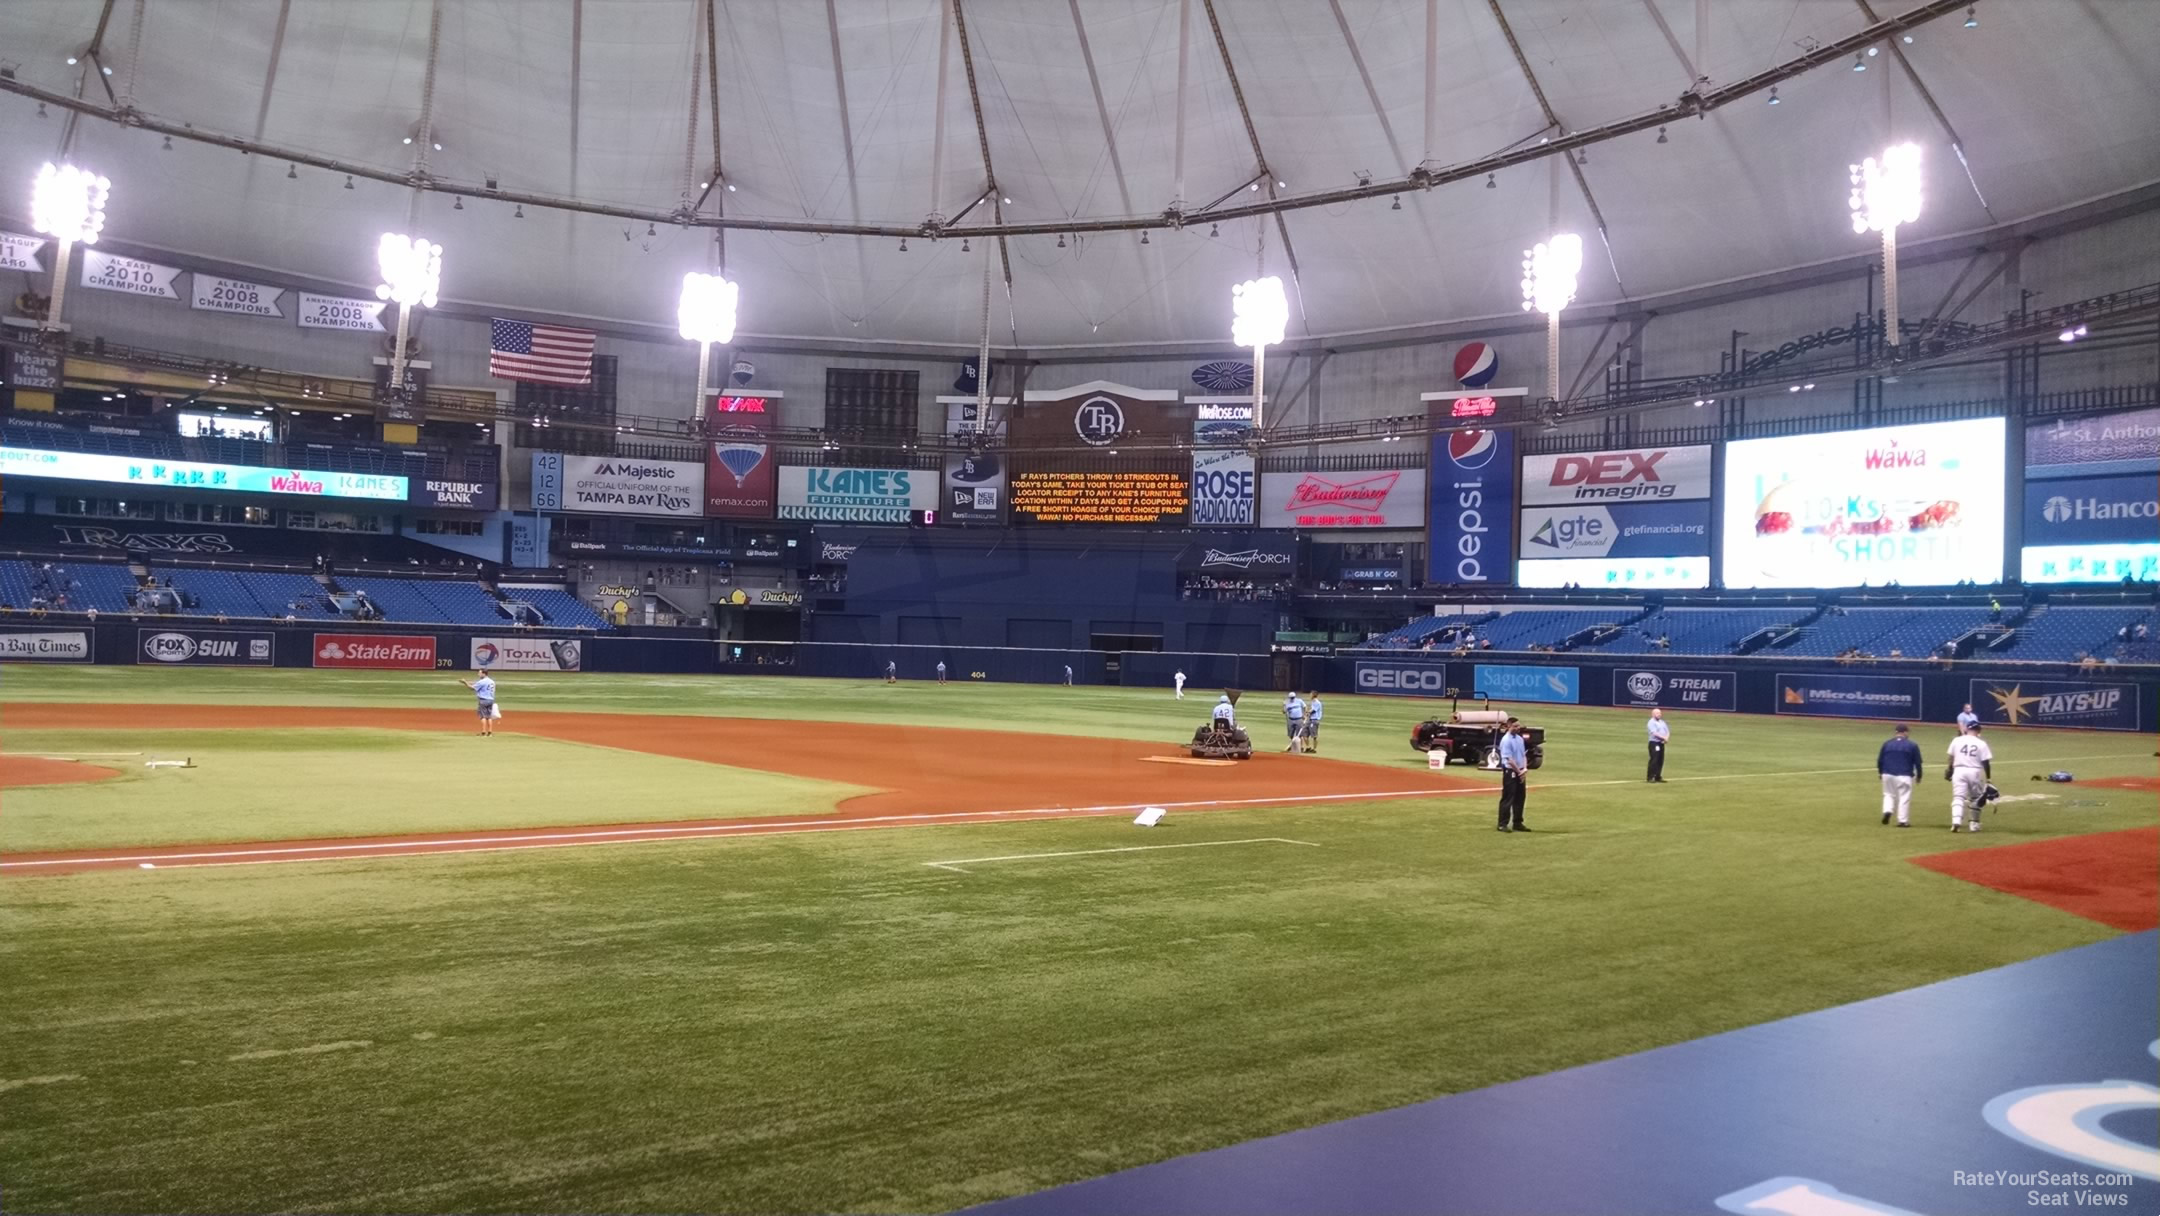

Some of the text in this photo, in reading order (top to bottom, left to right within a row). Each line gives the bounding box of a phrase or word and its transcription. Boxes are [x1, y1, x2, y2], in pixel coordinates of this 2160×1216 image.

[126, 261, 152, 270] EAST
[105, 266, 154, 284] 2010
[89, 275, 166, 296] CHAMPIONS
[213, 288, 259, 304] 2008
[199, 298, 271, 314] CHAMPIONS
[319, 305, 362, 320] 2008
[304, 316, 374, 330] CHAMPIONS
[22, 364, 48, 377] the
[14, 374, 56, 388] buzz?
[8, 418, 34, 427] Know
[1084, 406, 1116, 432] TB
[90, 425, 140, 436] tampabay.com
[2075, 429, 2097, 442] St.
[538, 456, 557, 470] 42
[1865, 449, 1926, 470] Wawa
[618, 464, 675, 480] Majestic
[1549, 452, 1668, 486] DEX
[271, 475, 323, 494] Wawa
[426, 481, 483, 494] REPUBLIC
[540, 475, 554, 488] 12
[577, 480, 616, 490] OFFICIAL
[618, 483, 658, 492] UNIFORM
[808, 469, 911, 495] KANE'S
[1194, 471, 1253, 499] ROSE
[438, 492, 471, 503] BANK
[1296, 484, 1387, 502] Budweiser
[1575, 483, 1676, 499] imaging
[537, 494, 556, 506] 66
[576, 492, 624, 504] TAMPA
[628, 494, 654, 505] BAY
[711, 498, 768, 507] remax.com
[812, 497, 904, 506] FURNITURE
[1194, 500, 1252, 523] RADIOLOGY
[1454, 482, 1488, 580] pepsi
[1559, 515, 1704, 542] gte gtefinancial.org
[1567, 537, 1609, 549] financial
[1208, 553, 1252, 562] Budweiser
[1252, 554, 1290, 564] PORCH
[598, 585, 640, 598] Ducky's
[761, 591, 802, 604] Ducky's
[8, 638, 35, 654] Bay
[39, 638, 81, 652] Times
[156, 639, 238, 656] FOX SUN
[504, 649, 550, 658] TOTAL
[437, 658, 452, 667] 370
[1359, 668, 1441, 690] GEICO
[1484, 668, 1542, 691] Sagicor
[1636, 678, 1721, 690] FOX STREAM
[1682, 691, 1708, 702] LIVE
[1810, 689, 1912, 701] MicroLumen
[2038, 691, 2120, 713] RAYS UP
[1220, 709, 1229, 717] 42
[1960, 744, 1978, 757] 42
